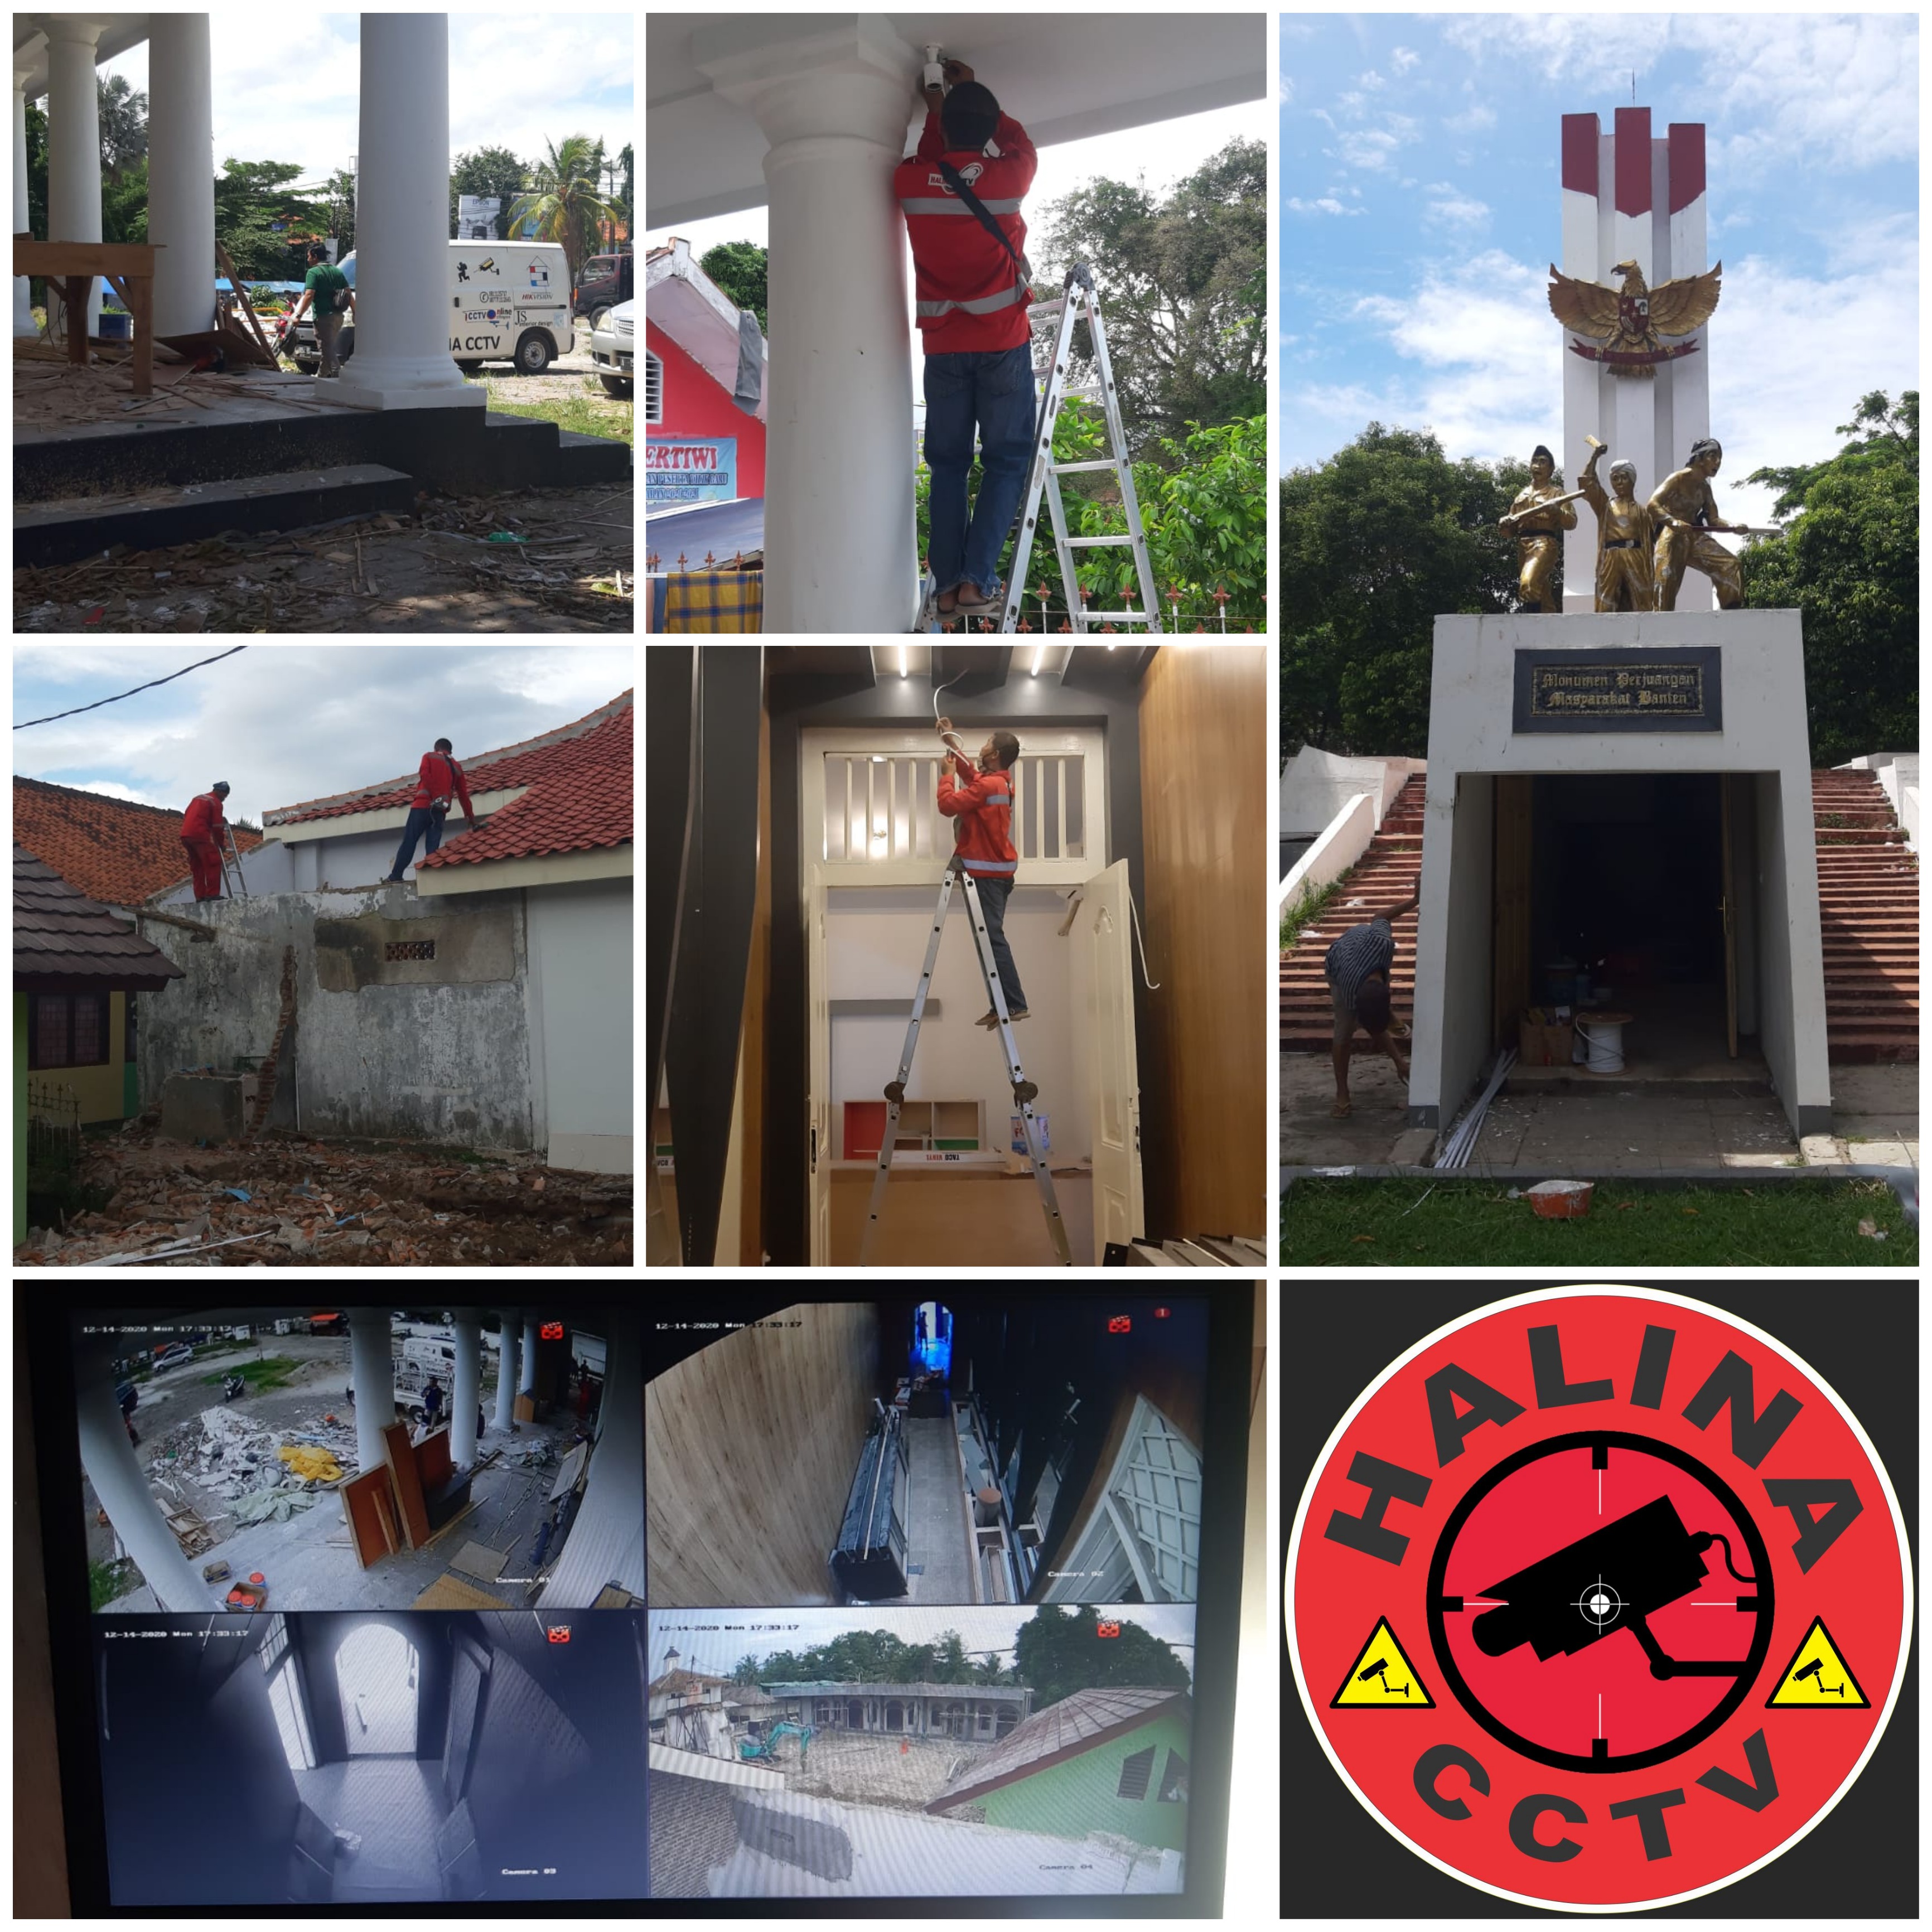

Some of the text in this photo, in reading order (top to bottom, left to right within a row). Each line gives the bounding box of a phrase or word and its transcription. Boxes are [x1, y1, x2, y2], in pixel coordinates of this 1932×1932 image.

[515, 310, 527, 325] JS
[449, 335, 500, 351] A CCTV
[646, 446, 717, 470] ERTIWI
[1542, 674, 1608, 688] Monumen
[1638, 690, 1687, 707] Banten
